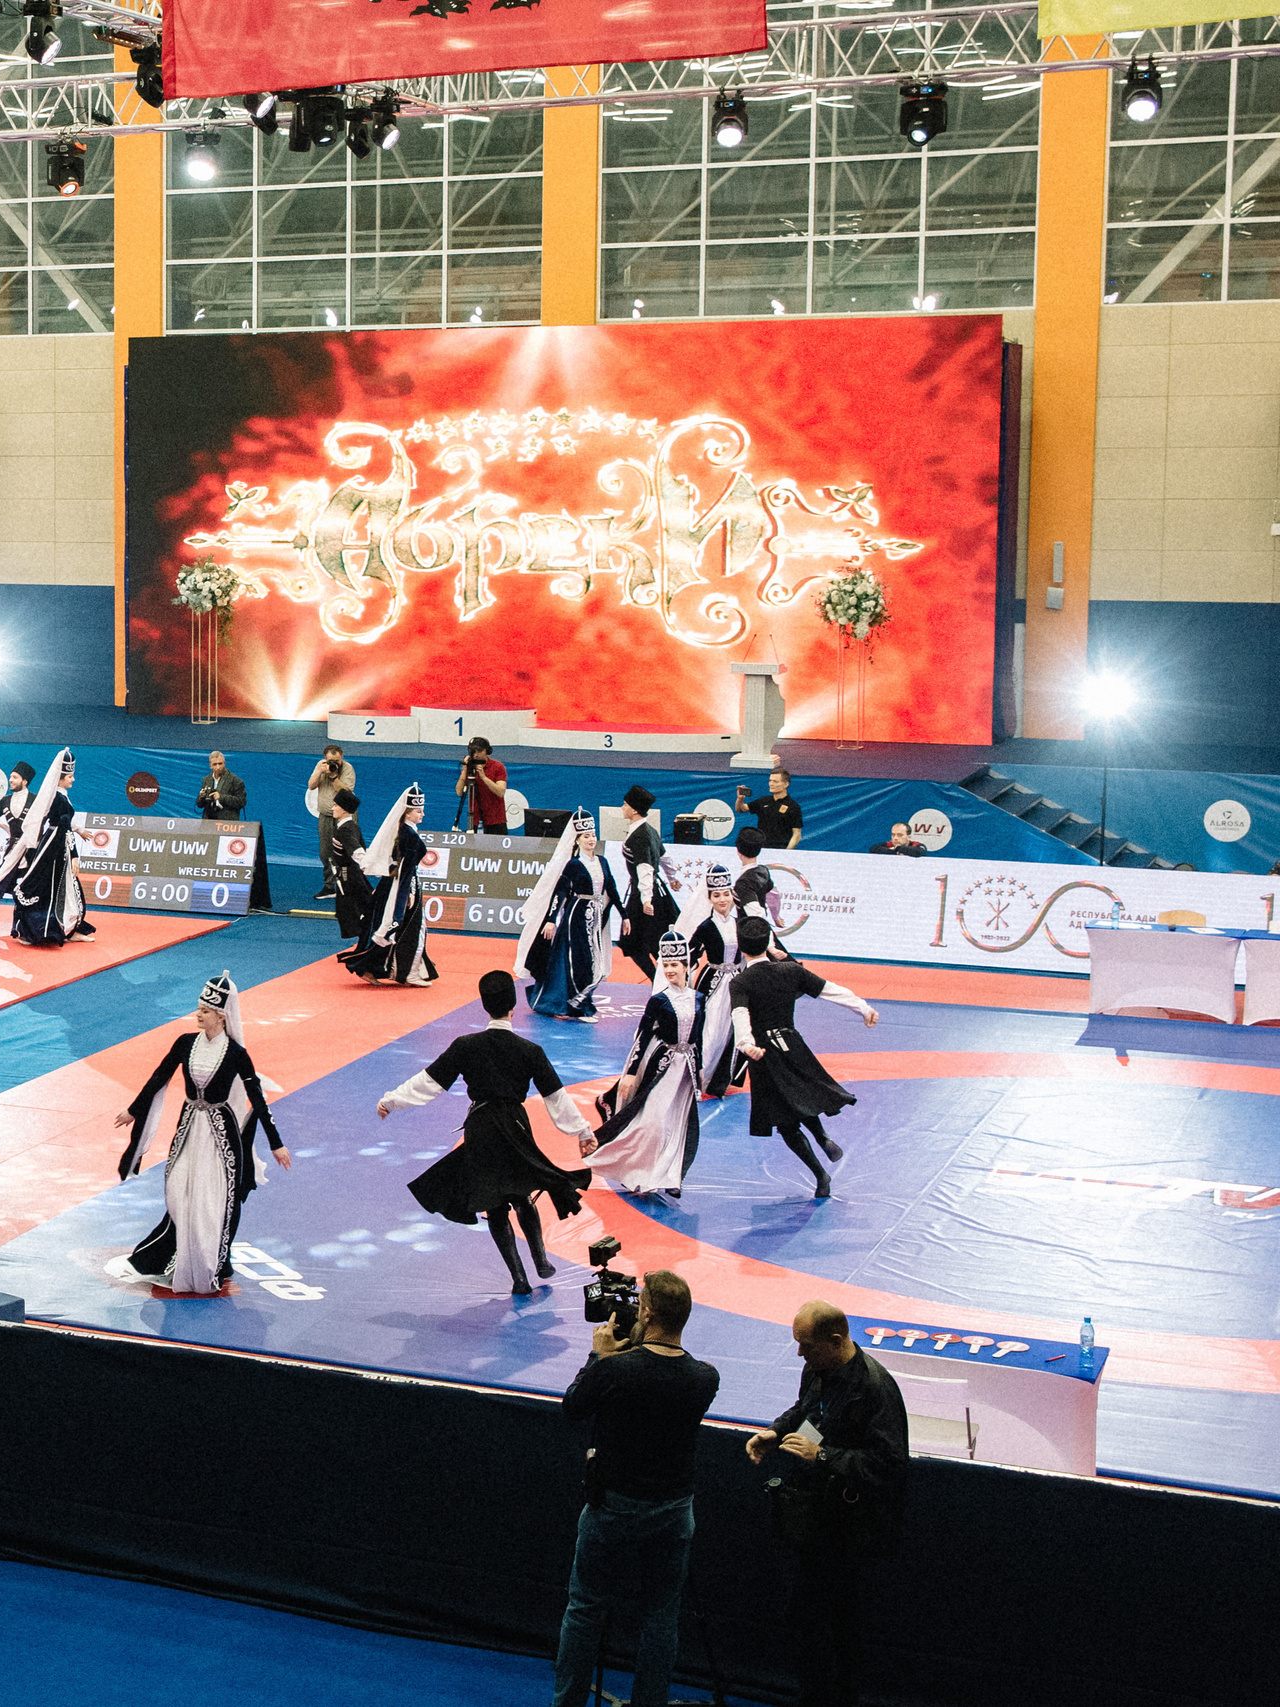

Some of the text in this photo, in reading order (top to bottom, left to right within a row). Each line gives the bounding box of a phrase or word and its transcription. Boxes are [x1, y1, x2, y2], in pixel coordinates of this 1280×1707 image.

[365, 720, 376, 736] 2
[453, 716, 464, 737] 1
[603, 734, 614, 748] 3
[92, 816, 135, 827] FS 120
[215, 822, 245, 833] Tour
[1209, 820, 1245, 828] ALROSA
[442, 834, 467, 845] 120
[128, 837, 167, 853] UWW
[171, 840, 209, 856] UWW
[79, 860, 150, 873] WRESTLER 1
[460, 856, 503, 873] UWW
[178, 866, 252, 880] WRESTLER 2
[94, 875, 113, 900] 0
[134, 881, 190, 903] 6:00
[420, 881, 486, 894] ESTLER 1
[211, 883, 230, 908] 0
[780, 892, 856, 904] УБЛИКА АДЫГЕЯ
[424, 897, 444, 922] 0
[796, 903, 855, 914] РЕСПУБЛИК
[1070, 910, 1157, 922] РЕСПУБЛКА АДЫ
[875, 1328, 886, 1337] 1
[905, 1330, 921, 1339] 2
[934, 1333, 953, 1342] 4
[972, 1337, 986, 1345] 5
